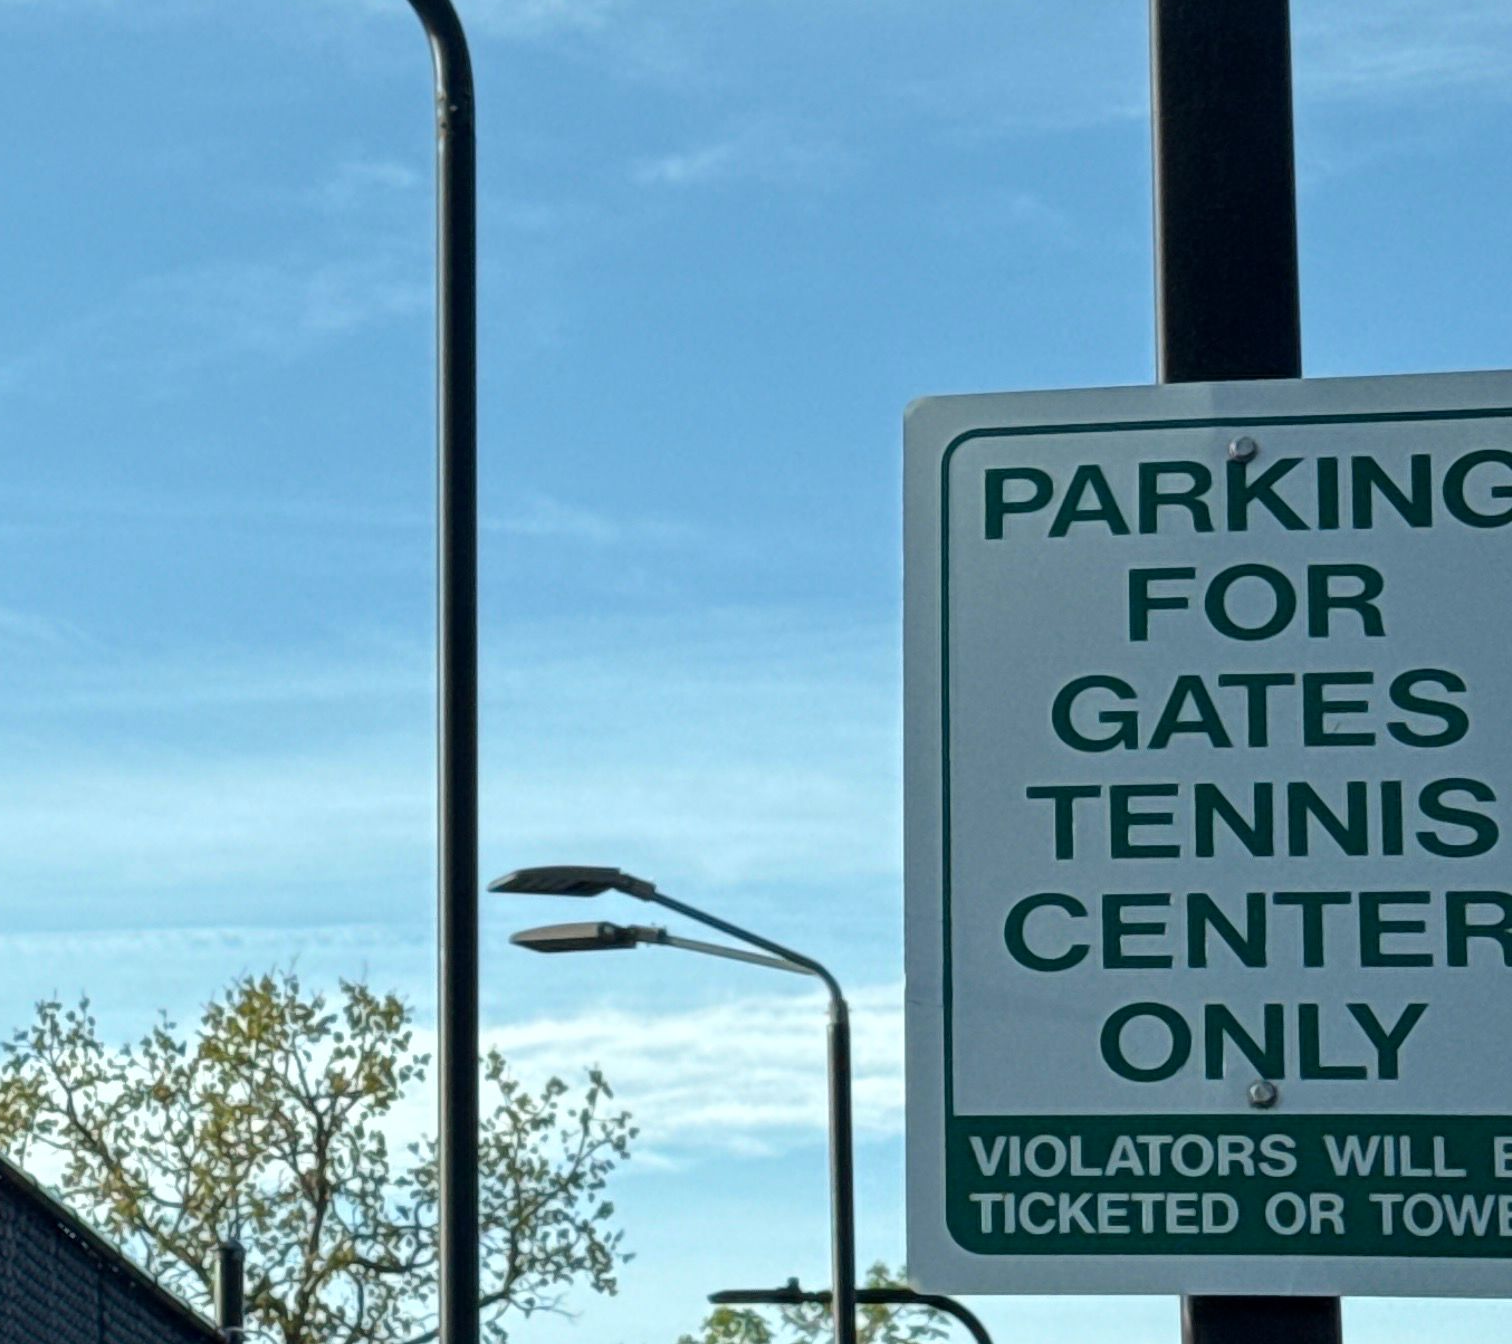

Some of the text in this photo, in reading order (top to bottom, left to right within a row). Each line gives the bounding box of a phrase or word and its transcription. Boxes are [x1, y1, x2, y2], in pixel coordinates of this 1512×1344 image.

[984, 449, 1512, 540] PARKING
[1127, 562, 1387, 643] FOR
[1050, 667, 1471, 752] GATES
[1025, 776, 1500, 860] TENNIS
[1002, 890, 1512, 974] CENTER
[1099, 1001, 1429, 1084] ONLY
[969, 1133, 1298, 1179] VIOLATORS
[1322, 1133, 1467, 1178] WILL
[968, 1191, 1241, 1236] TICKETED
[1264, 1191, 1346, 1236] OR
